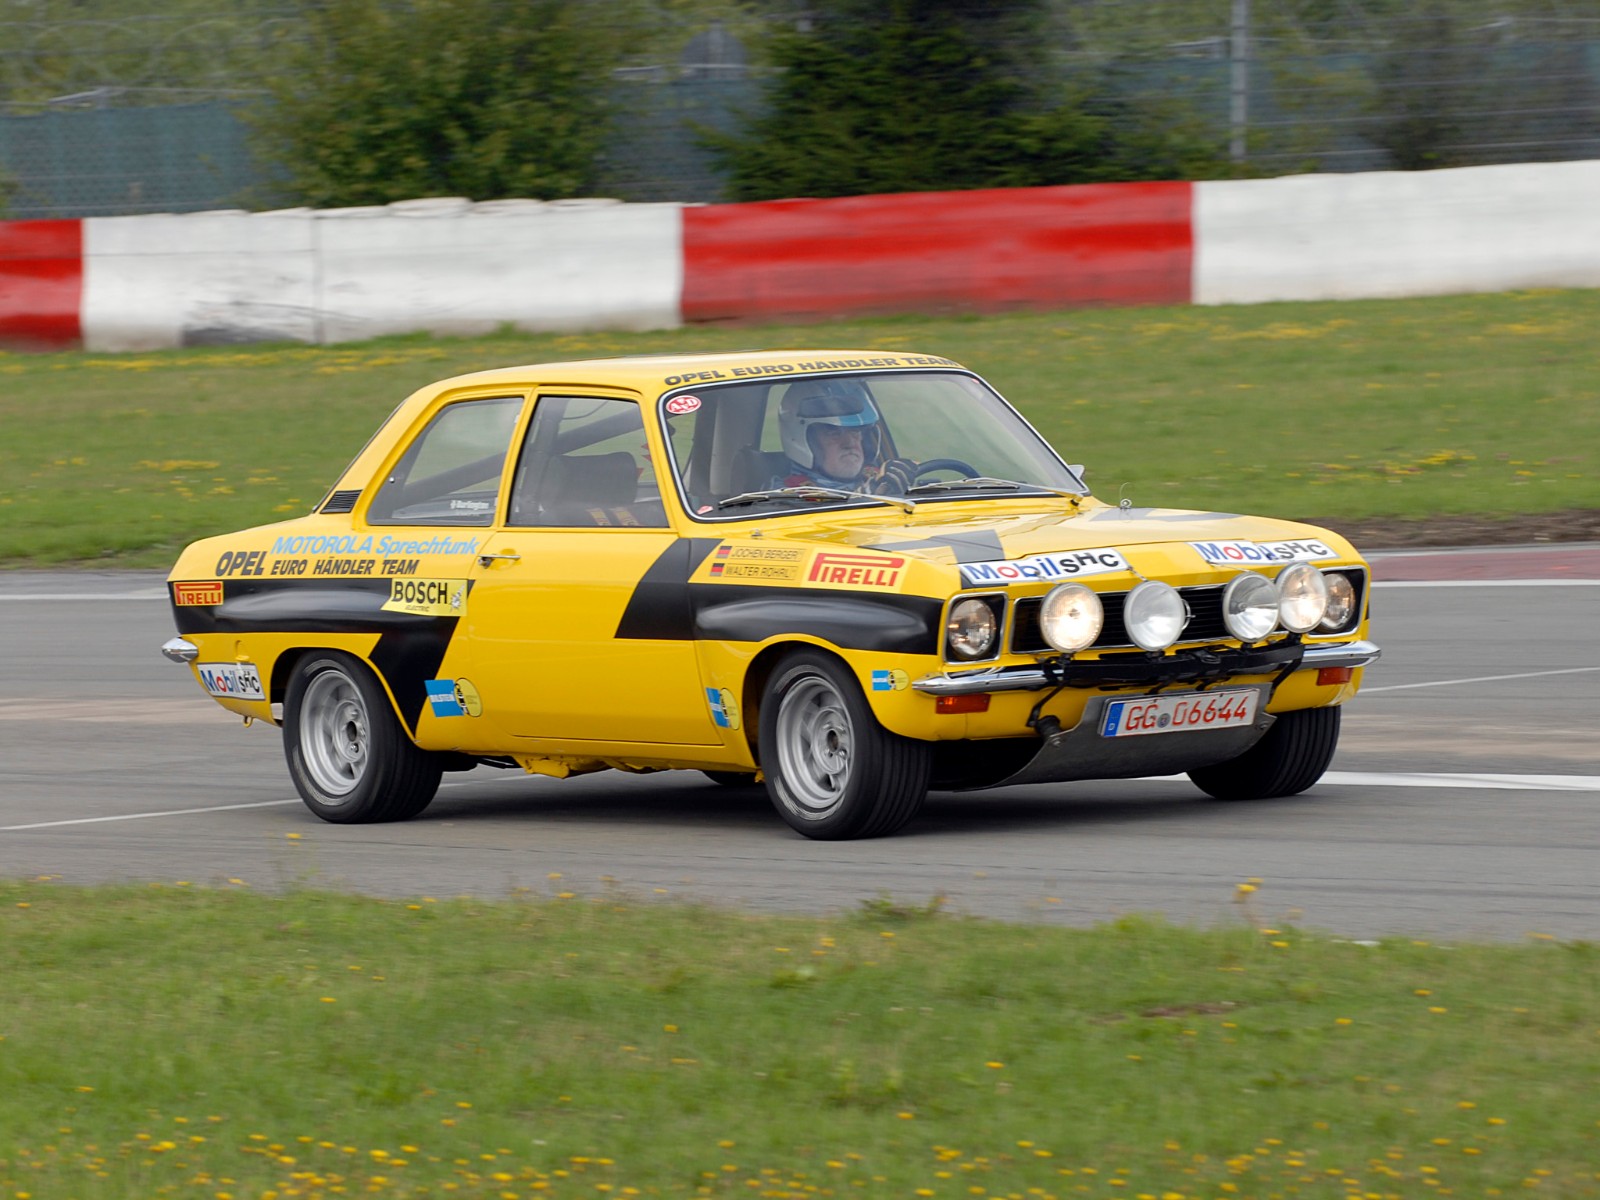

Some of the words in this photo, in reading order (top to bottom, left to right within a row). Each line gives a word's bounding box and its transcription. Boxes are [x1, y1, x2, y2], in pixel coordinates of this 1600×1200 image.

[664, 370, 726, 386] OPEL
[731, 364, 794, 377] EURO
[900, 356, 959, 367] TEAM
[270, 535, 374, 554] MOTOROLA
[375, 535, 479, 558] Sprechfunk
[731, 548, 764, 558] JOCHEN
[764, 549, 799, 560] BERGER
[215, 551, 267, 577] OPEL
[270, 559, 313, 575] EURO
[312, 556, 375, 575] HÄNDLER
[380, 559, 420, 575] TEAM
[808, 552, 905, 586] PIRELLI
[175, 583, 222, 605] PIRELLI
[391, 581, 448, 604] BOSCH
[1125, 704, 1159, 731] GG
[1172, 696, 1249, 726] 06644
